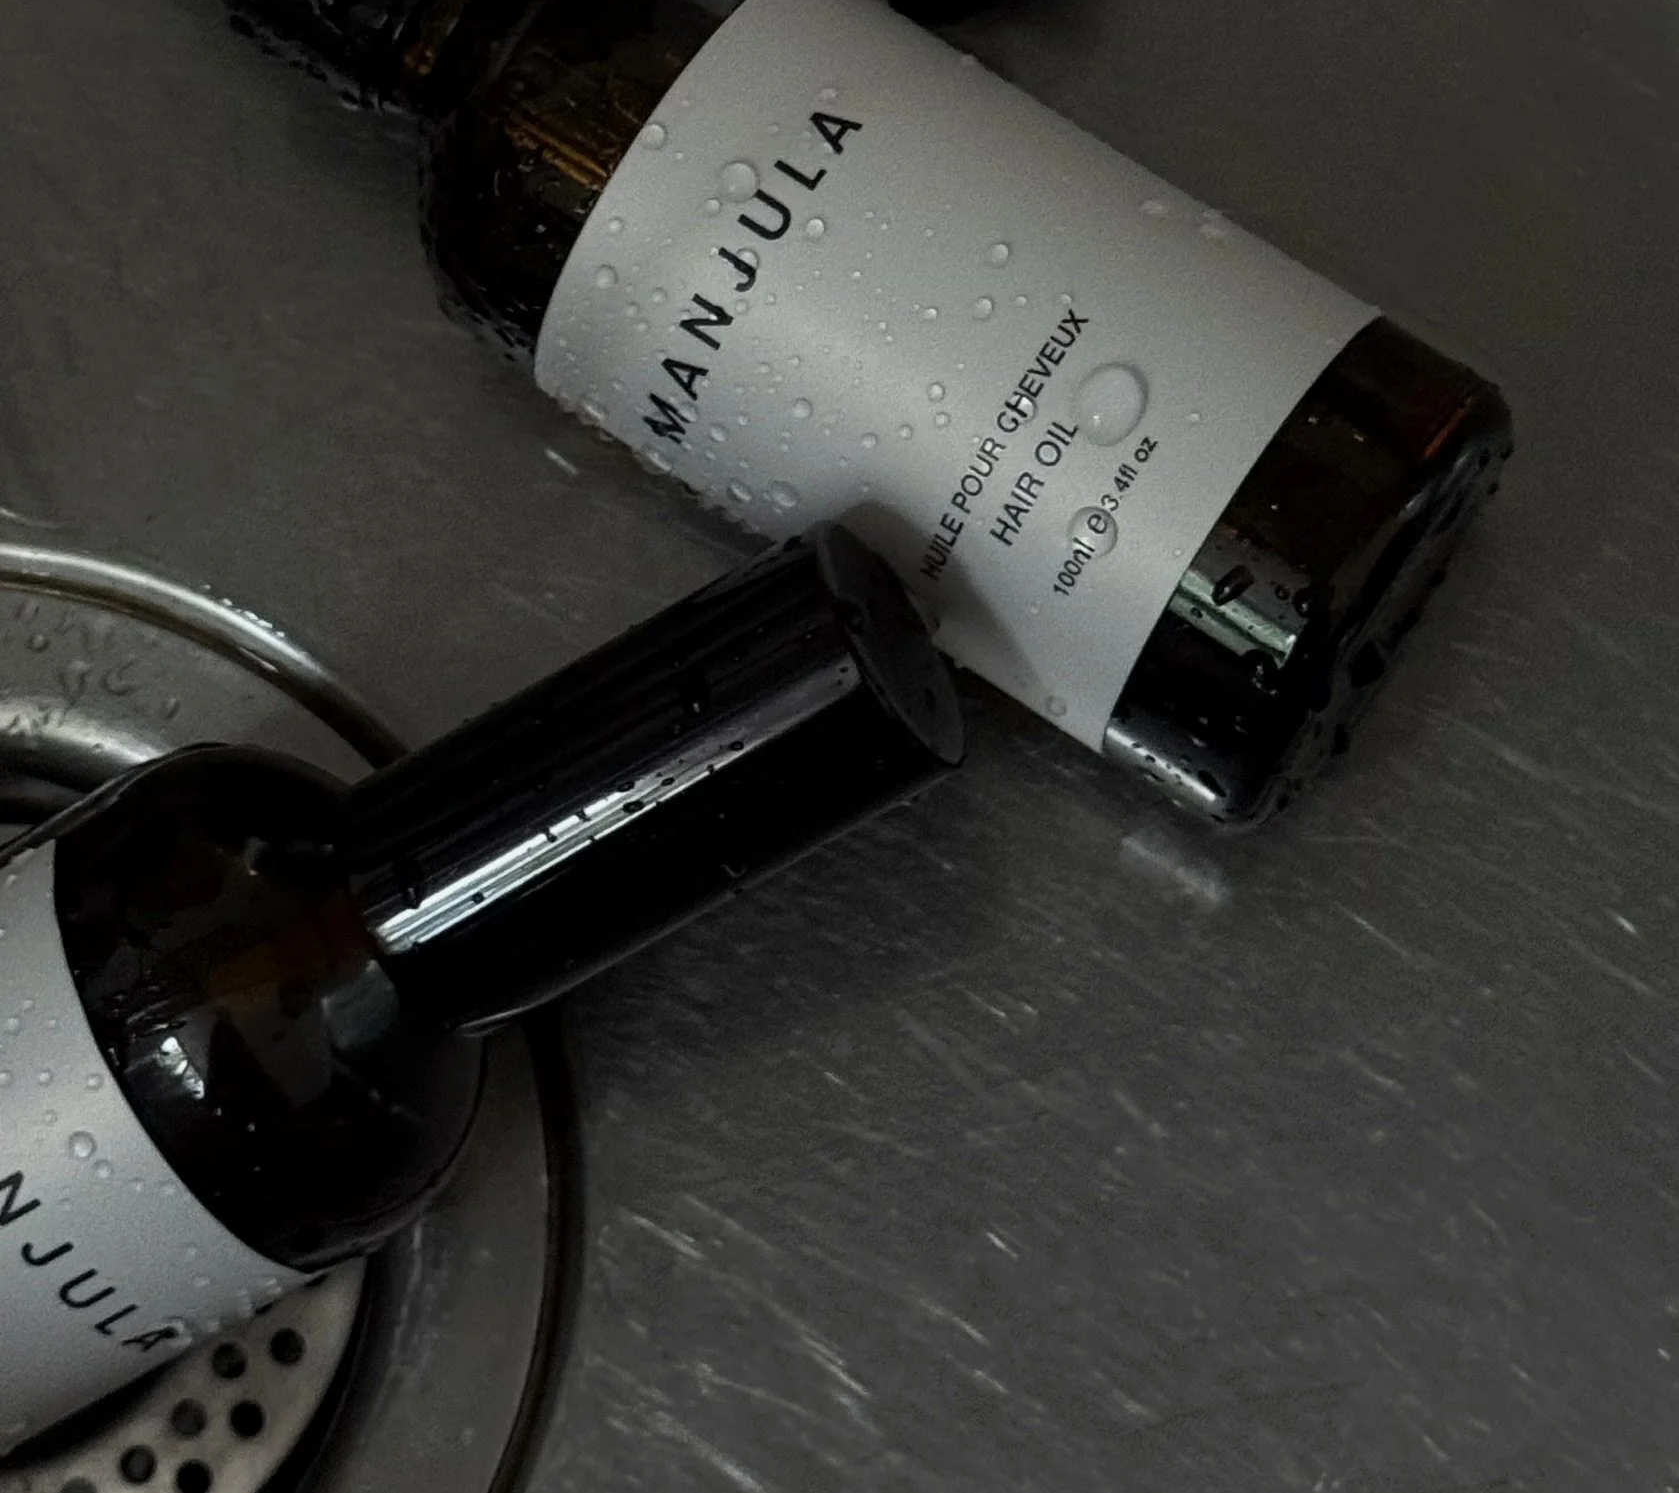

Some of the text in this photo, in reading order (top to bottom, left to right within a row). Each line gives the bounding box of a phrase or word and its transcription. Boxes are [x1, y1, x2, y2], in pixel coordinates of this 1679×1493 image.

[642, 111, 863, 444] MANJULA
[920, 309, 1090, 582] HUILE POUR CHEVEUX
[989, 421, 1079, 547] HAIR OIL
[1134, 436, 1159, 463] oz
